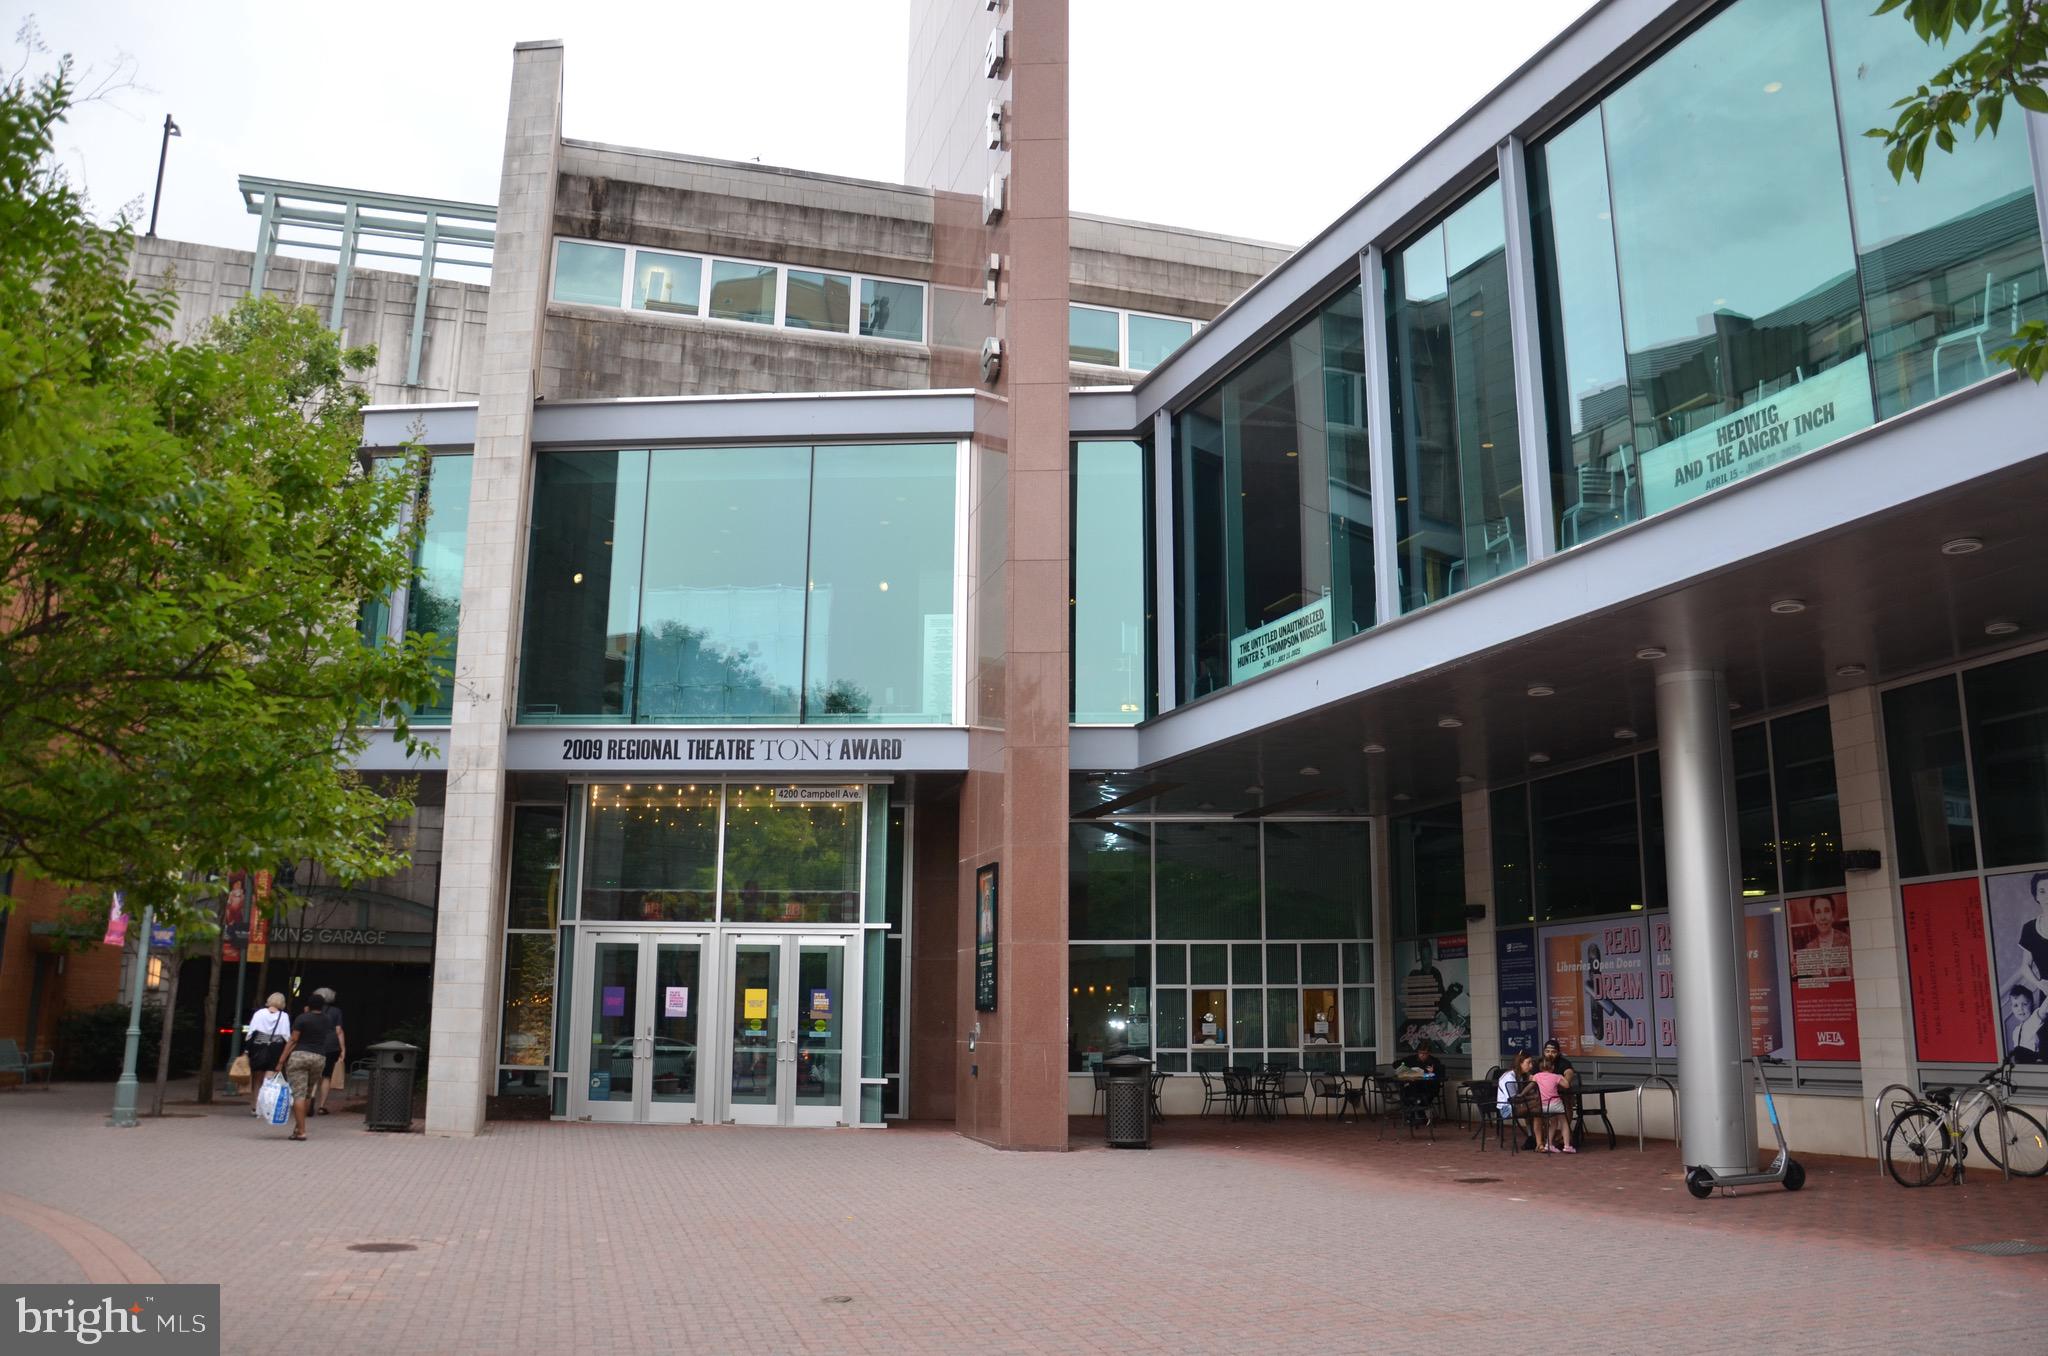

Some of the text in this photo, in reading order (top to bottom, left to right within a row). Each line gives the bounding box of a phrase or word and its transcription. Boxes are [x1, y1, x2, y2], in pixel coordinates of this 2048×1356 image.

[1716, 404, 1779, 447] HEDWIG
[1674, 402, 1835, 488] AND THE ANGRY INCH
[1706, 472, 1728, 490] APRIL
[1730, 469, 1738, 483] 15
[1240, 608, 1324, 654] THE UNTITLED UNAUTHORIZED
[1238, 622, 1327, 668] HUNTER S. THOMPSON MUSICAL
[563, 738, 902, 761] 2009 REGIONAL THEATRE TONY AWARD
[778, 788, 862, 800] 4200 Campbell Ave.
[272, 928, 386, 944] KING GARAGE
[1604, 927, 1641, 955] READ
[1556, 958, 1640, 972] Libraries Open Doors
[1592, 973, 1644, 1000] DREAM
[1604, 1020, 1646, 1046] BUILD
[1816, 1032, 1842, 1042] WETA
